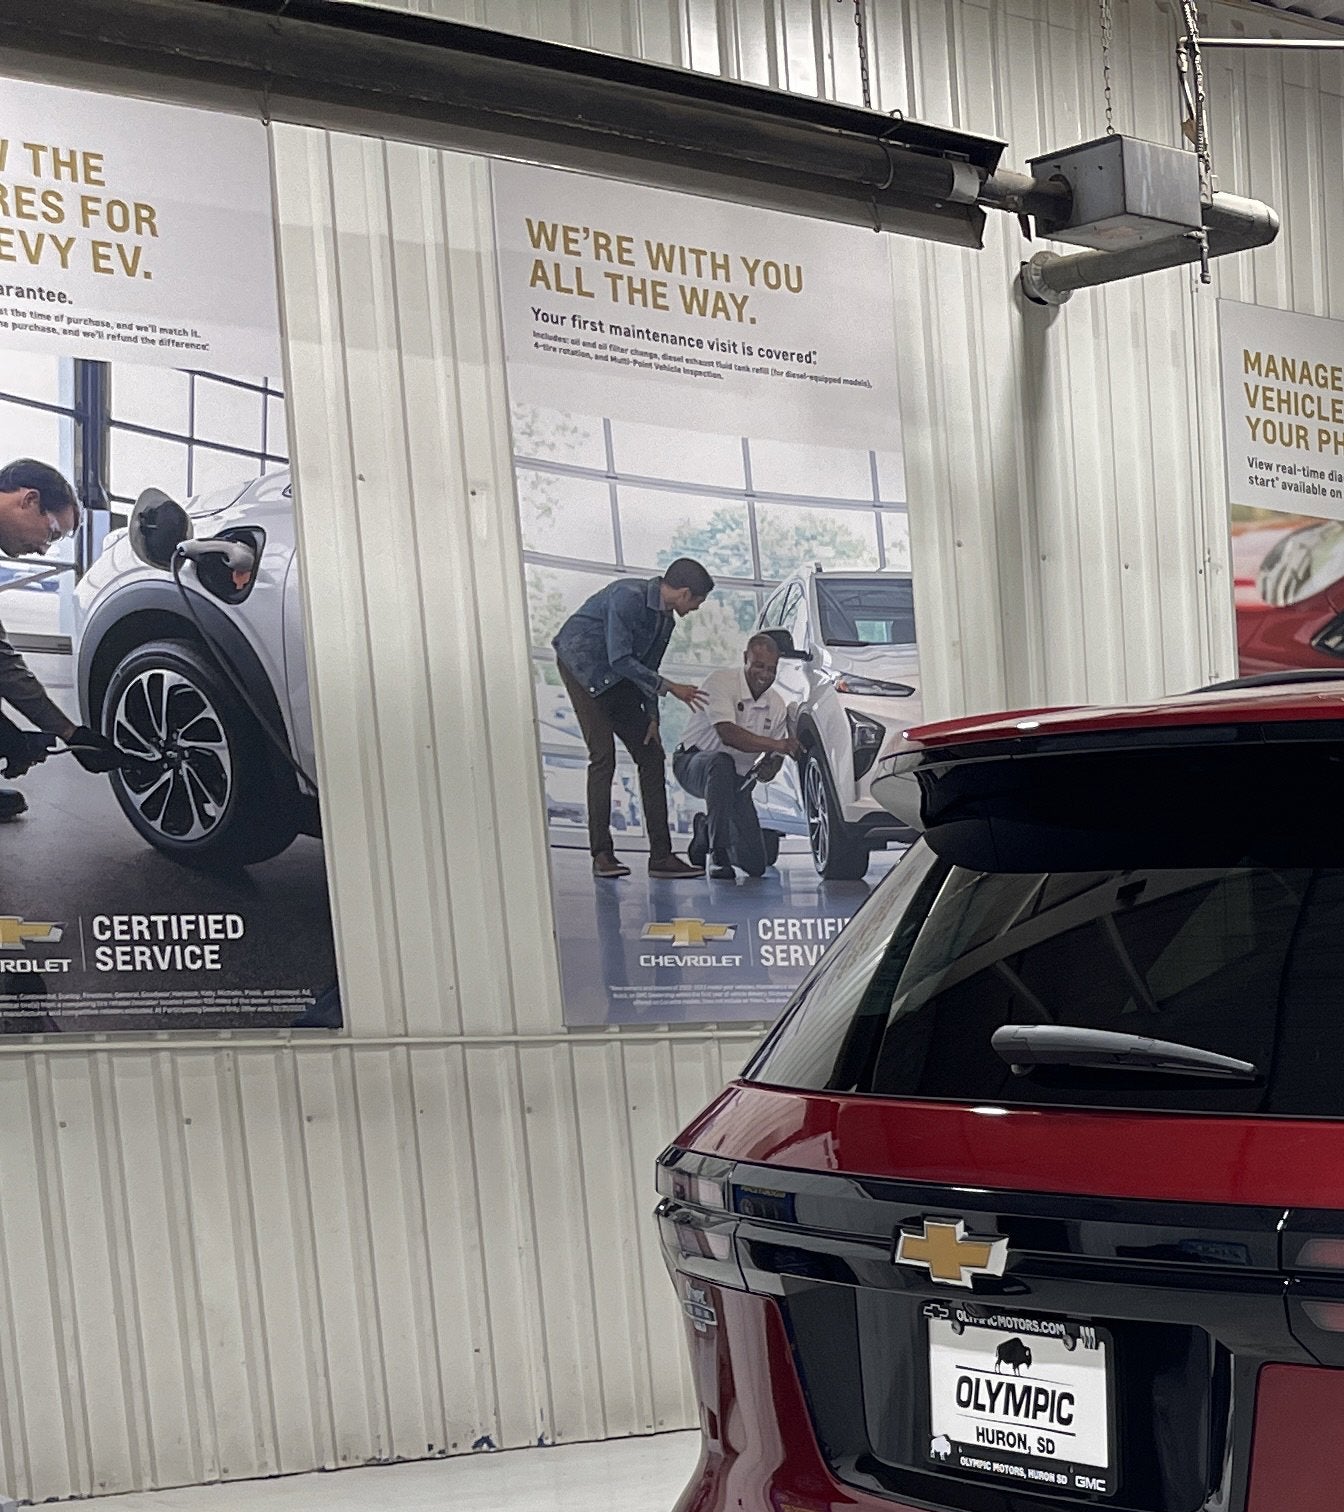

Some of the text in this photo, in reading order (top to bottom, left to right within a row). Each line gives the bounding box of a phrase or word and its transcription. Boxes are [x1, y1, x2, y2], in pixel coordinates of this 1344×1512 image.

[23, 142, 105, 186] THE
[80, 194, 159, 238] FOR
[91, 240, 152, 280] EV.
[525, 217, 803, 293] WE'RE WITH YOU
[529, 259, 757, 325] ALL THE WAY.
[11, 308, 27, 319] the
[29, 311, 52, 322] time
[54, 314, 64, 323] of
[66, 316, 114, 330] purchase,
[116, 322, 134, 331] and
[531, 306, 566, 326] Your
[571, 314, 605, 333] first
[609, 324, 704, 349] maintenance
[707, 338, 738, 354] visit
[742, 342, 754, 356] is
[63, 328, 80, 337] and
[106, 333, 139, 344] refund
[141, 336, 156, 345] the
[1243, 349, 1344, 392] MANAGE
[1244, 382, 1344, 425] VEHICLE
[1245, 415, 1310, 451] YOUR
[1247, 456, 1273, 471] View
[1276, 463, 1325, 480] real-time
[1281, 481, 1327, 497] available
[1330, 489, 1343, 499] on
[92, 914, 246, 941] CERTIFIED
[758, 918, 851, 940] CERTIFI
[95, 944, 222, 972] SERVICE
[639, 954, 743, 968] CHEVROLET
[956, 1375, 1075, 1426] OLYMPIC
[976, 1426, 1056, 1455] HURON, SD
[960, 1456, 1068, 1485] OLYMPIC MOTORS, HURON SD
[1075, 1475, 1106, 1492] GMC
